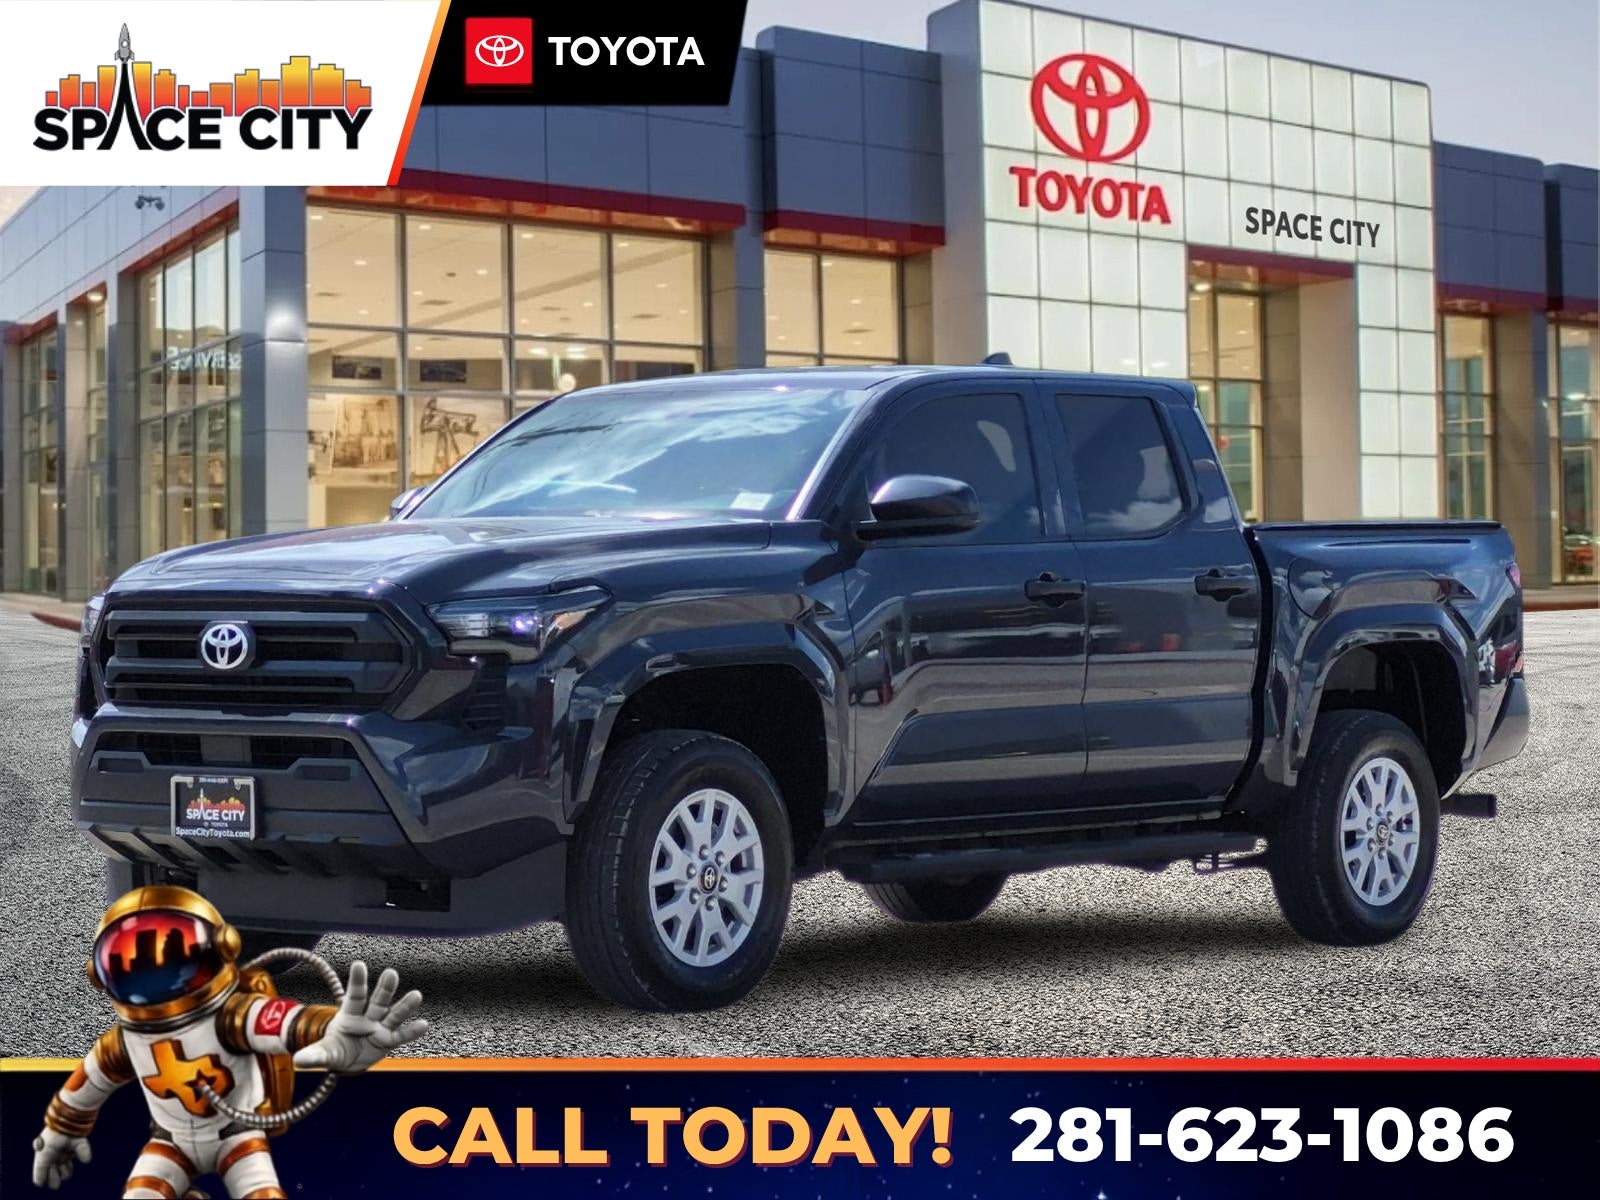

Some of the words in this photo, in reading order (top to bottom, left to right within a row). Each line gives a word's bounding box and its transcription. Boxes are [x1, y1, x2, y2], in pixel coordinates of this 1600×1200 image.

[1009, 166, 1171, 225] TOYOTA
[1245, 206, 1323, 242] SPACE
[1329, 217, 1381, 248] CITY
[186, 807, 220, 820] SPACE
[221, 808, 246, 821] CITY
[175, 826, 250, 838] SpaceCityToyota.com
